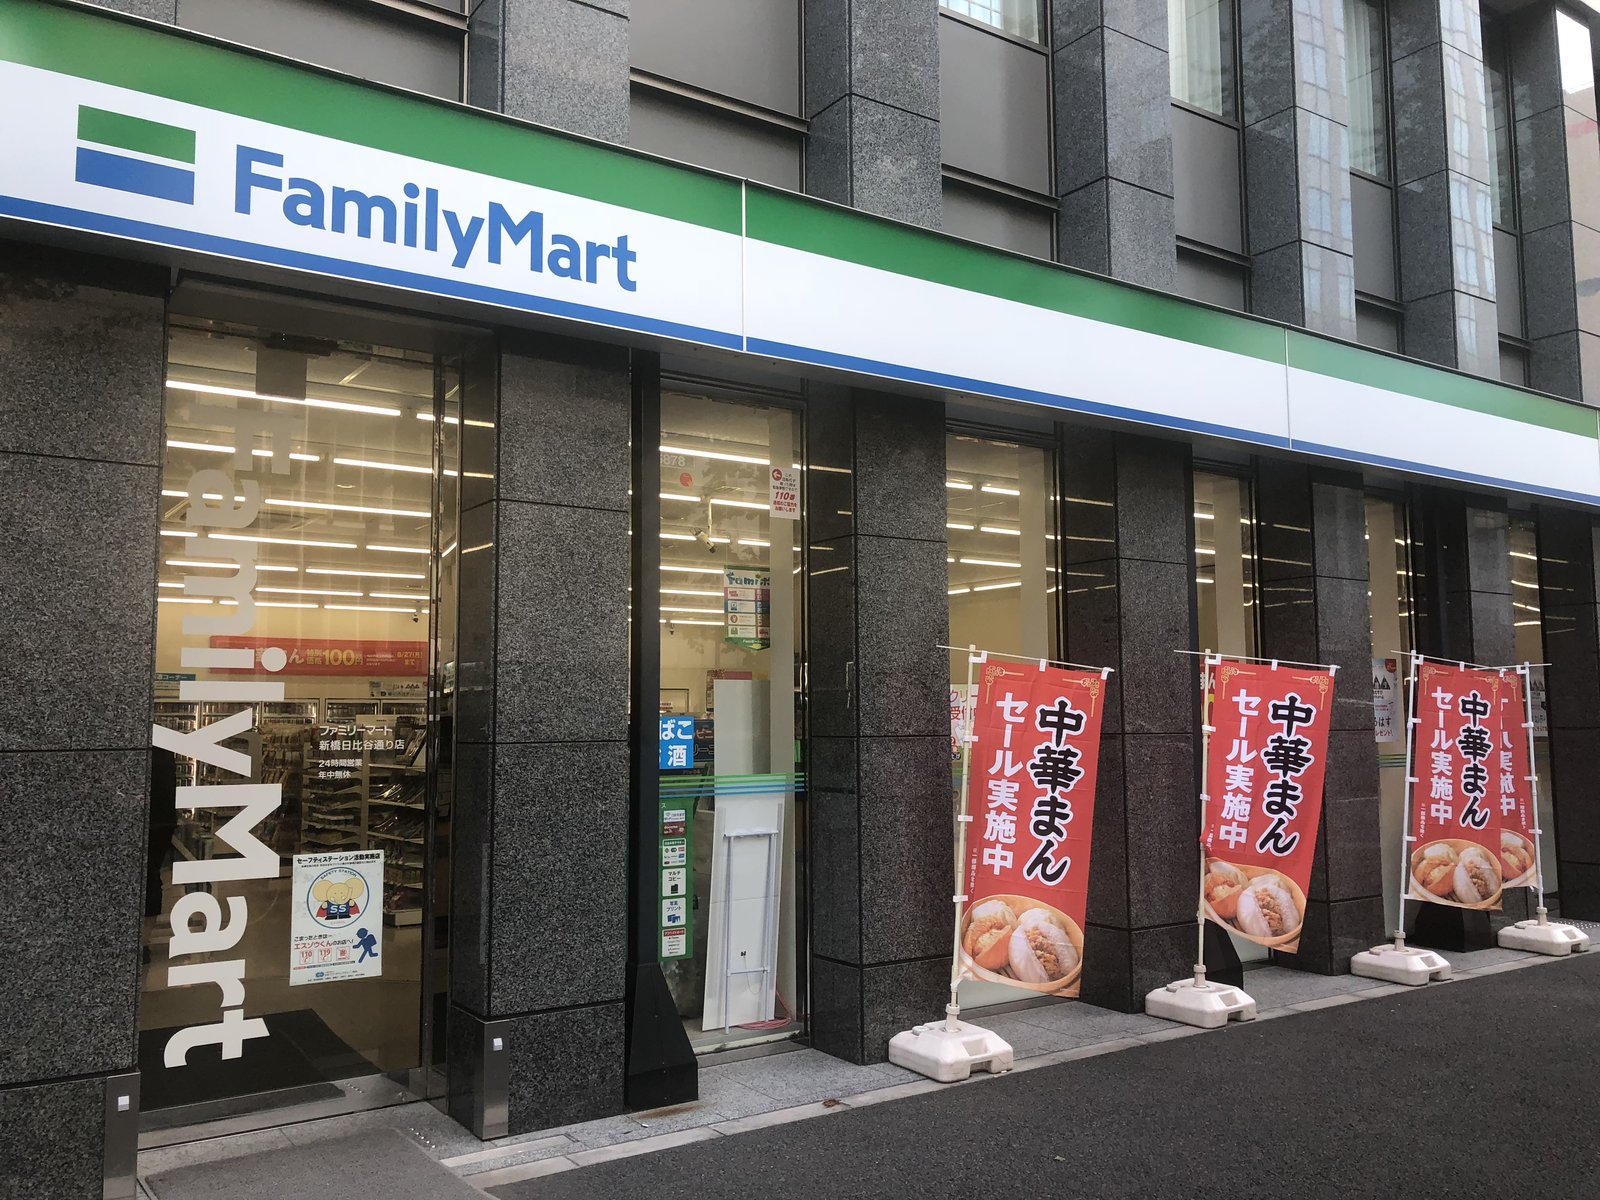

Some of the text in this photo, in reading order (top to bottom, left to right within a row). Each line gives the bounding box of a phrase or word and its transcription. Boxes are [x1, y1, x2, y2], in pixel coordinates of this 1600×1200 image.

[234, 144, 637, 292] FamilyMart
[152, 406, 305, 1069] FamilyMart
[318, 758, 362, 768] 24時間営業
[318, 770, 351, 779] 年中無休
[319, 725, 392, 736] ファミリーマート
[319, 740, 405, 751] 新橋日比谷通り店
[660, 719, 693, 740] ばこ
[982, 692, 1028, 876] セール実施中
[1025, 698, 1085, 885] 中華まん
[1219, 689, 1261, 849] セール実施中
[1257, 693, 1316, 856] 中華まん
[1430, 686, 1453, 825] セール実施中
[1458, 691, 1492, 829] 中華まん
[330, 904, 347, 913] SS
